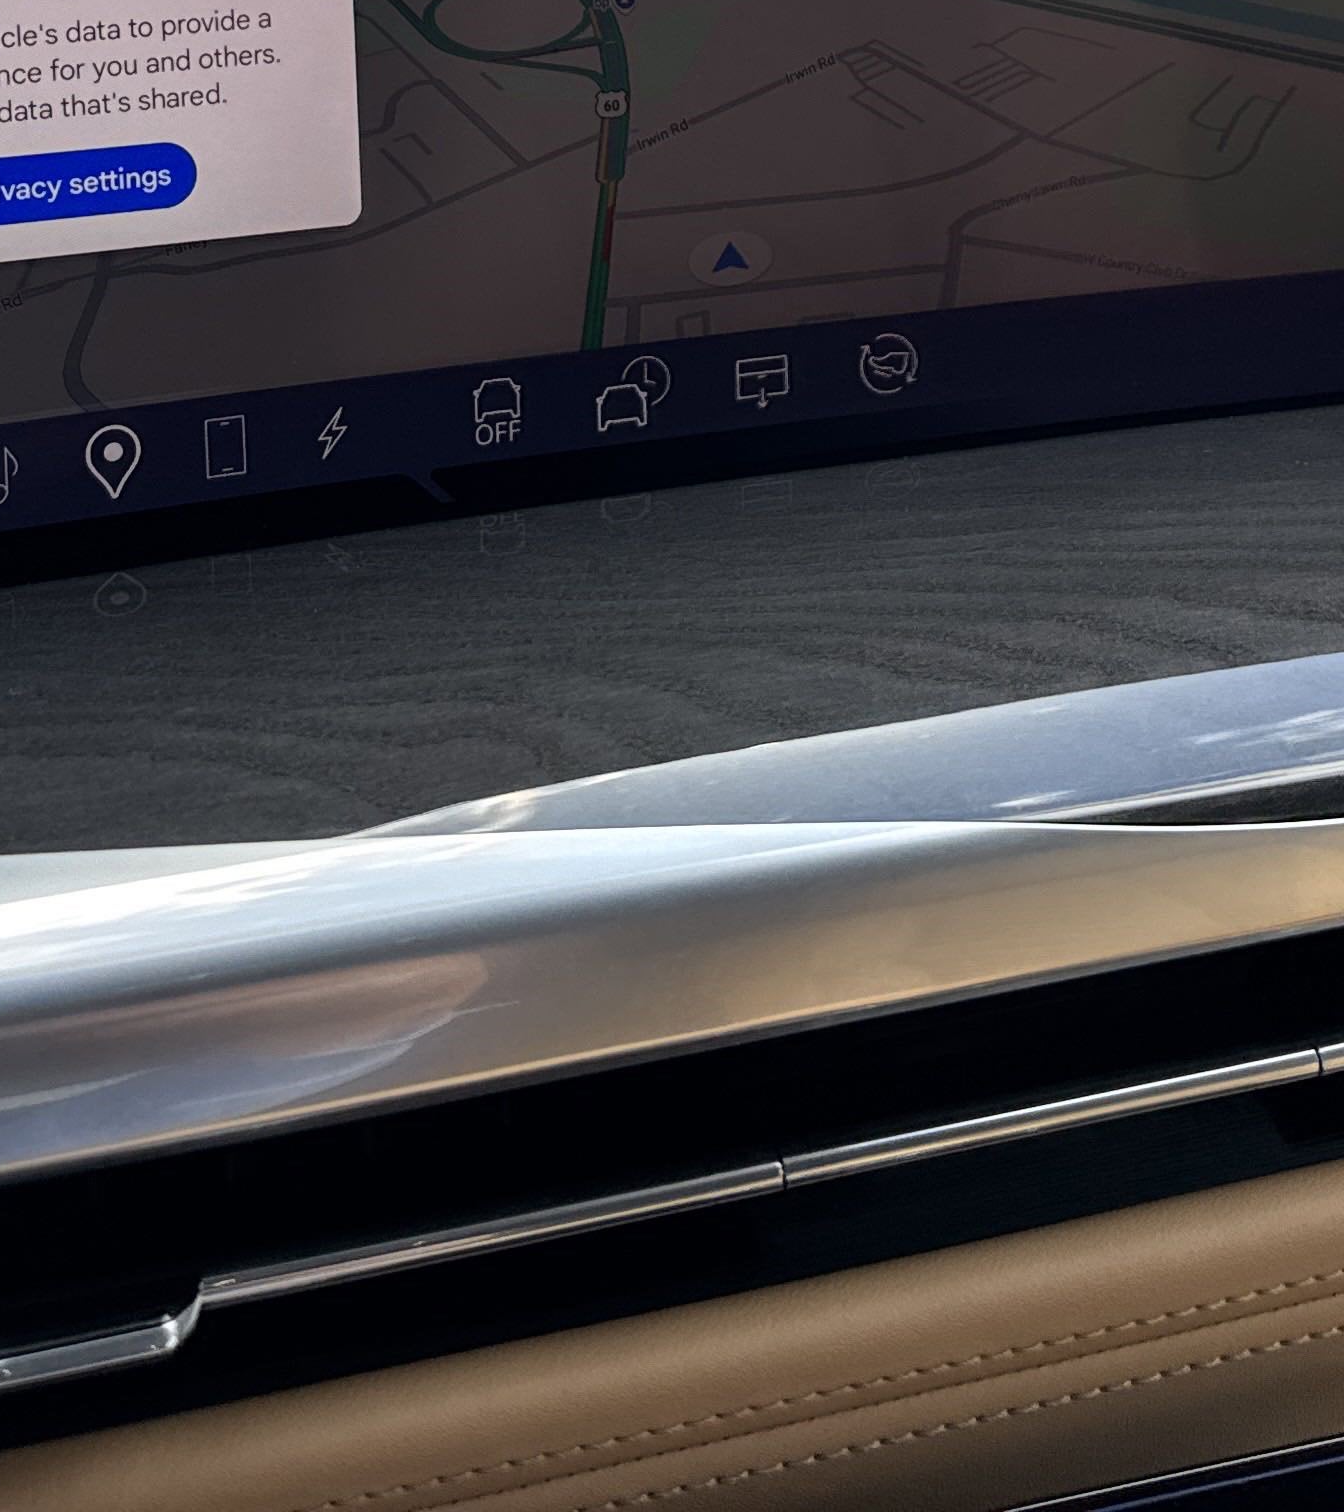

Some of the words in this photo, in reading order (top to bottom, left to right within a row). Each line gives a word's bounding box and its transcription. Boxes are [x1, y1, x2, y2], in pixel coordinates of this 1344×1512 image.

[66, 20, 120, 43] data
[129, 19, 152, 38] to
[162, 9, 250, 41] provide
[259, 13, 271, 28] a
[50, 58, 84, 81] for
[93, 59, 137, 83] you
[147, 48, 190, 73] and
[199, 46, 280, 69] others.
[786, 64, 816, 85] Irwin
[817, 53, 837, 70] Rd
[61, 93, 130, 117] that's
[139, 82, 227, 110] shared.
[604, 99, 620, 113] 60
[635, 130, 667, 152] Irwin
[668, 118, 690, 138] Rd
[70, 166, 171, 194] settings
[1, 291, 25, 310] Rd
[476, 420, 521, 445] OFF
